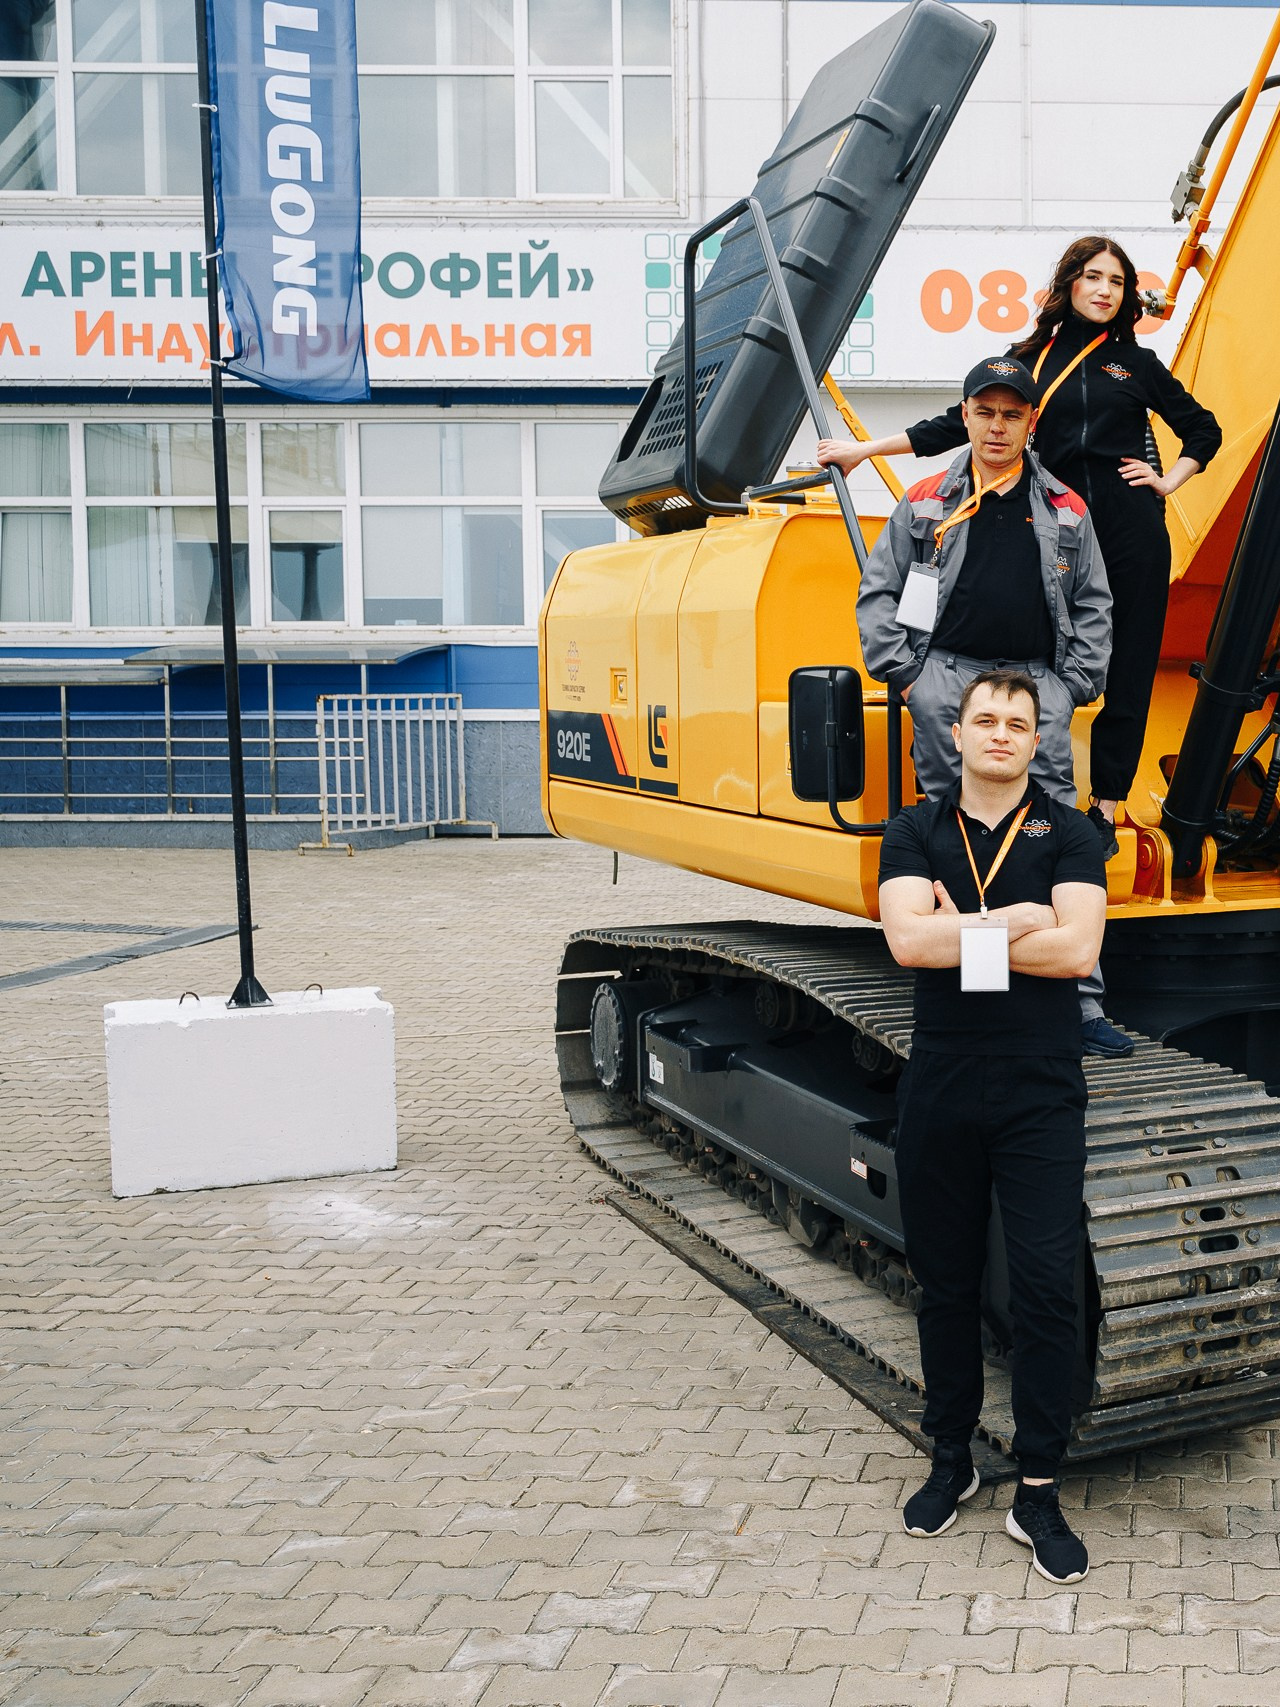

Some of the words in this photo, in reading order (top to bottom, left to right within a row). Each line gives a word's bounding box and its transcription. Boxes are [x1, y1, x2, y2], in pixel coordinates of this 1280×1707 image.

[263, 1, 323, 337] LIUGONG
[274, 240, 594, 298] ЕРОФЕЙ»
[557, 729, 592, 762] 920E
